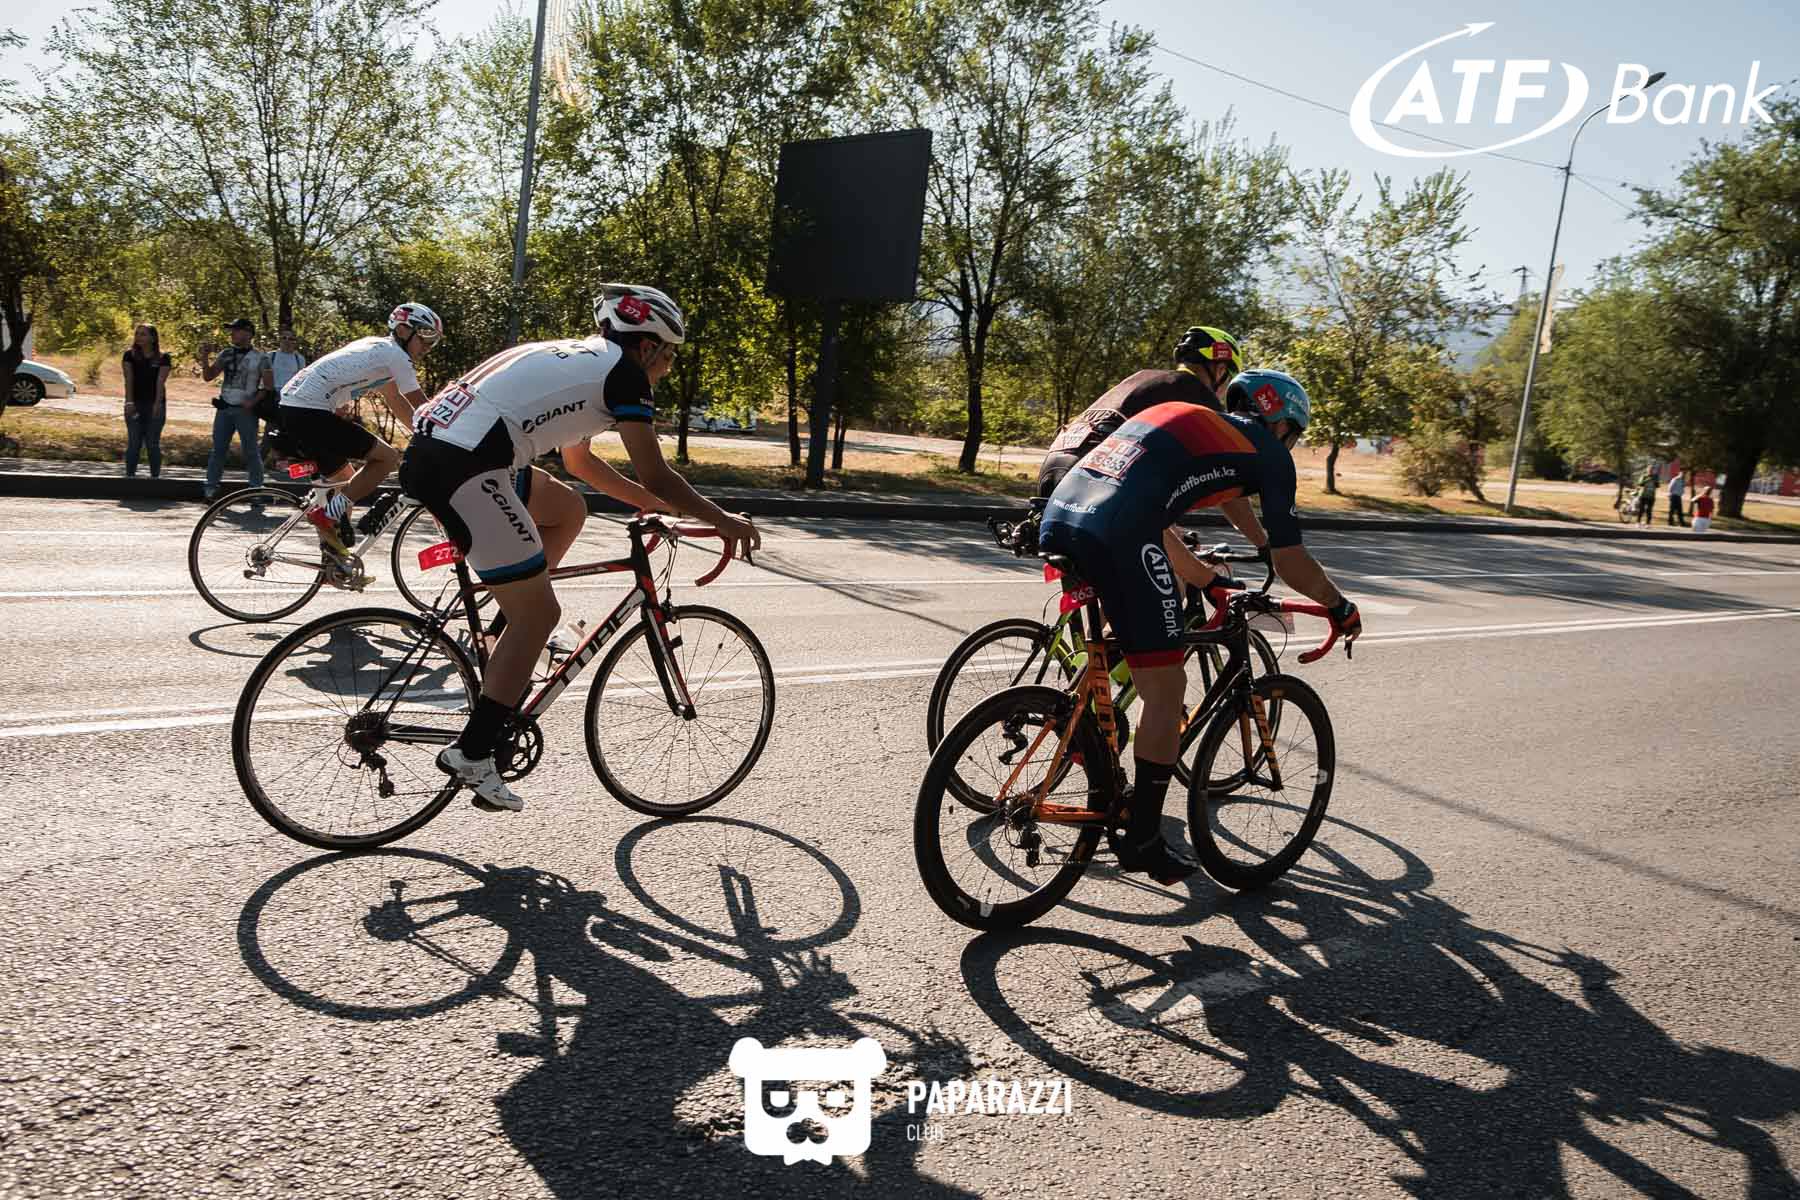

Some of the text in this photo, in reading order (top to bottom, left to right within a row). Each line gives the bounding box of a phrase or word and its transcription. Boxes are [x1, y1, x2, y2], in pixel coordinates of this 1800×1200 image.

[623, 304, 641, 319] 272
[433, 403, 454, 422] 272
[535, 399, 587, 426] GIANT
[492, 493, 536, 544] GIANT
[433, 546, 460, 561] 272
[1071, 586, 1095, 603] 363
[1161, 599, 1182, 638] Bank
